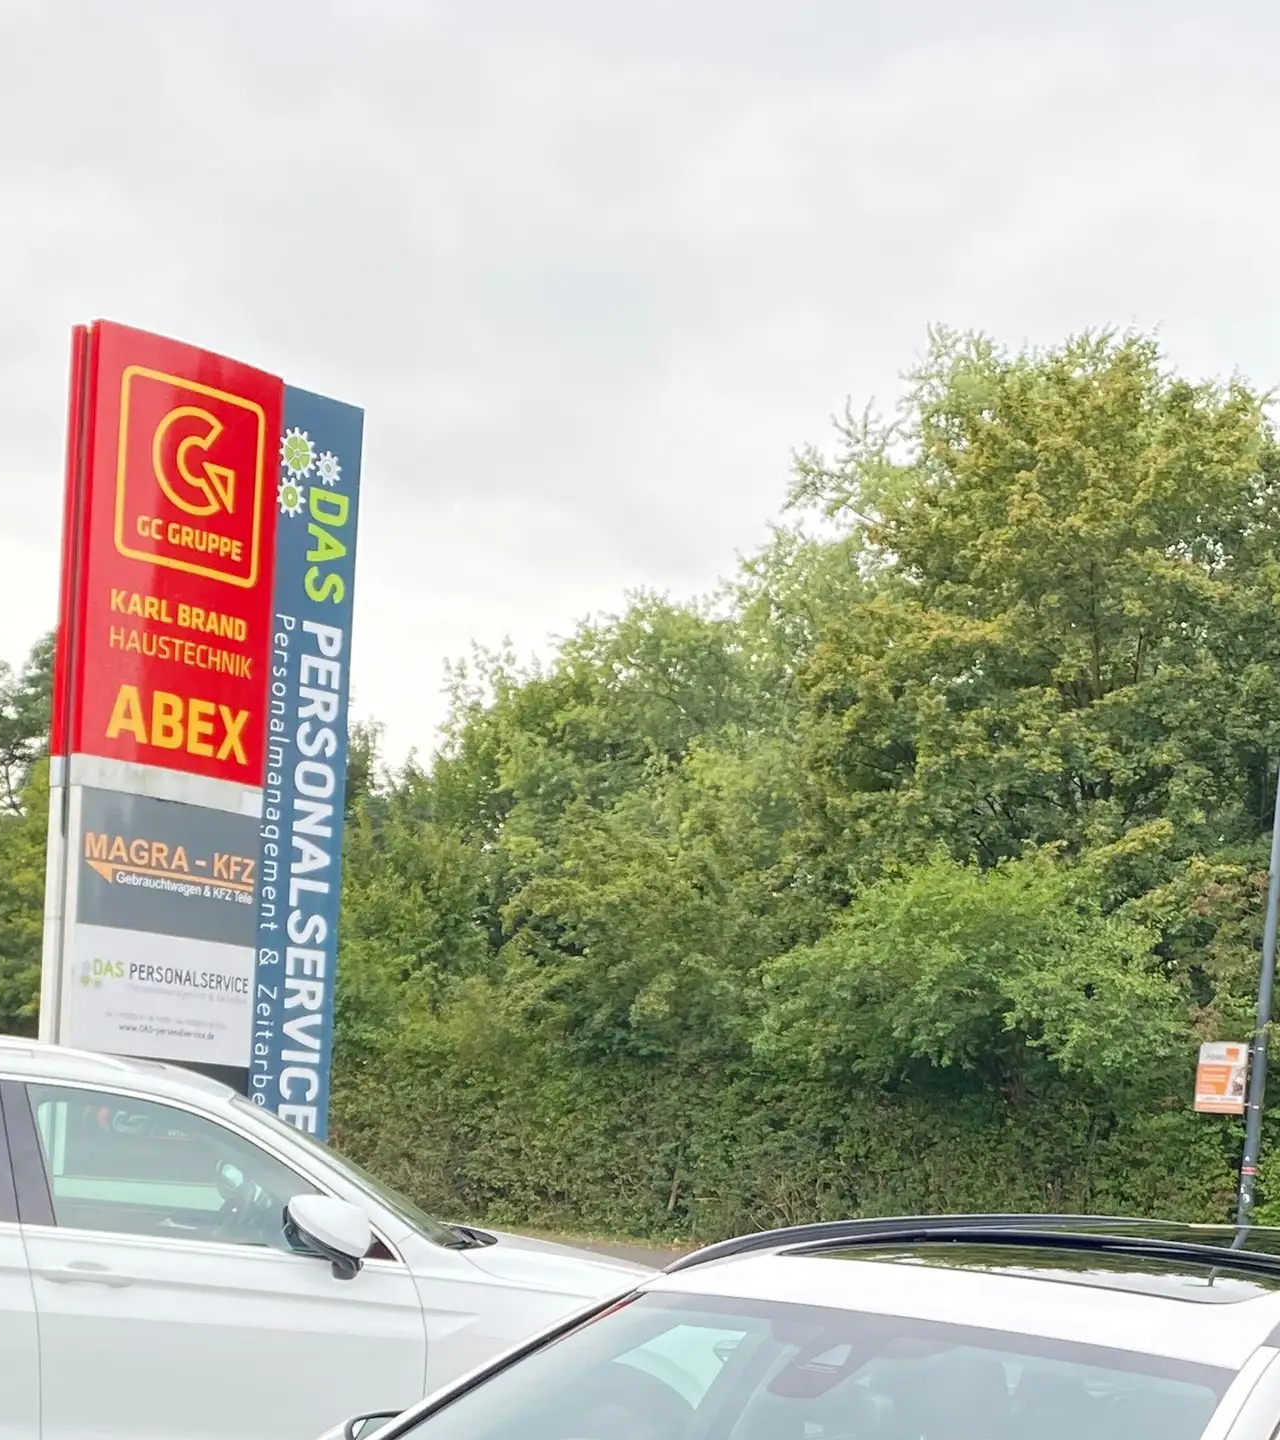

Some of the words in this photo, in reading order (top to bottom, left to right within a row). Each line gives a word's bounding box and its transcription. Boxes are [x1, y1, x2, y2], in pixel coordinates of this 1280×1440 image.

[136, 515, 163, 540] GC
[167, 523, 244, 561] GRUPPE
[304, 486, 349, 604] DAS
[110, 588, 173, 623] KARL
[177, 603, 247, 642] BRAND
[109, 625, 252, 680] HAUSTECHNIK
[105, 684, 250, 766] ABEX
[259, 613, 296, 932] Personalmanagement
[85, 832, 189, 872] MAGRA
[213, 852, 256, 884] KFZ
[278, 620, 342, 1134] PERSONALSERVICE
[116, 871, 201, 897] Gebrauchtwagen
[203, 885, 211, 898] &
[213, 887, 232, 902] KFZ
[234, 891, 253, 905] Teile
[93, 958, 124, 978] DAS
[129, 962, 249, 994] PERSONALSERVICE
[259, 947, 278, 965] &
